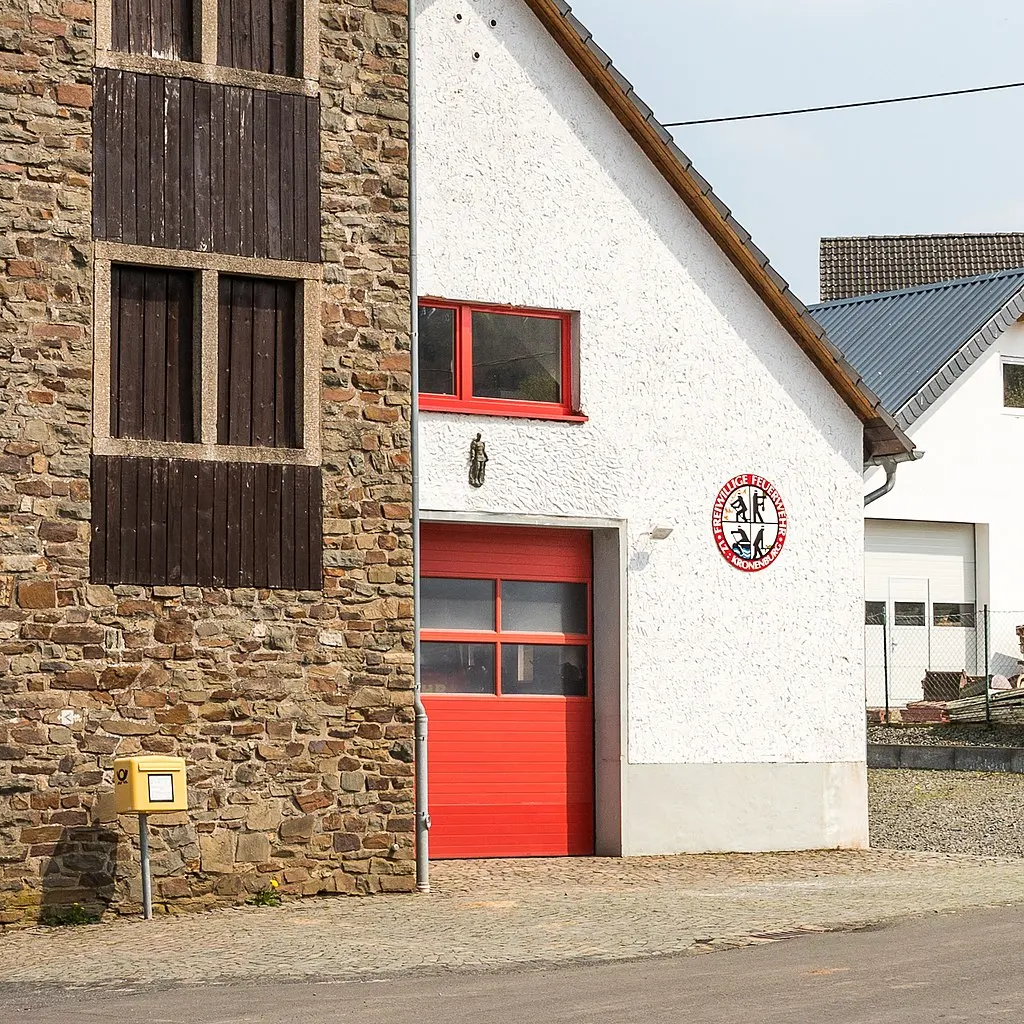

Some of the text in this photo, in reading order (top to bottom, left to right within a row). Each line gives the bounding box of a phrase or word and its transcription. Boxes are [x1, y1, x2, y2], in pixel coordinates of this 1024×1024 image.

[713, 475, 787, 536] FREIWILLIGE FEUERWEHR
[731, 541, 782, 570] KRONENBURG
